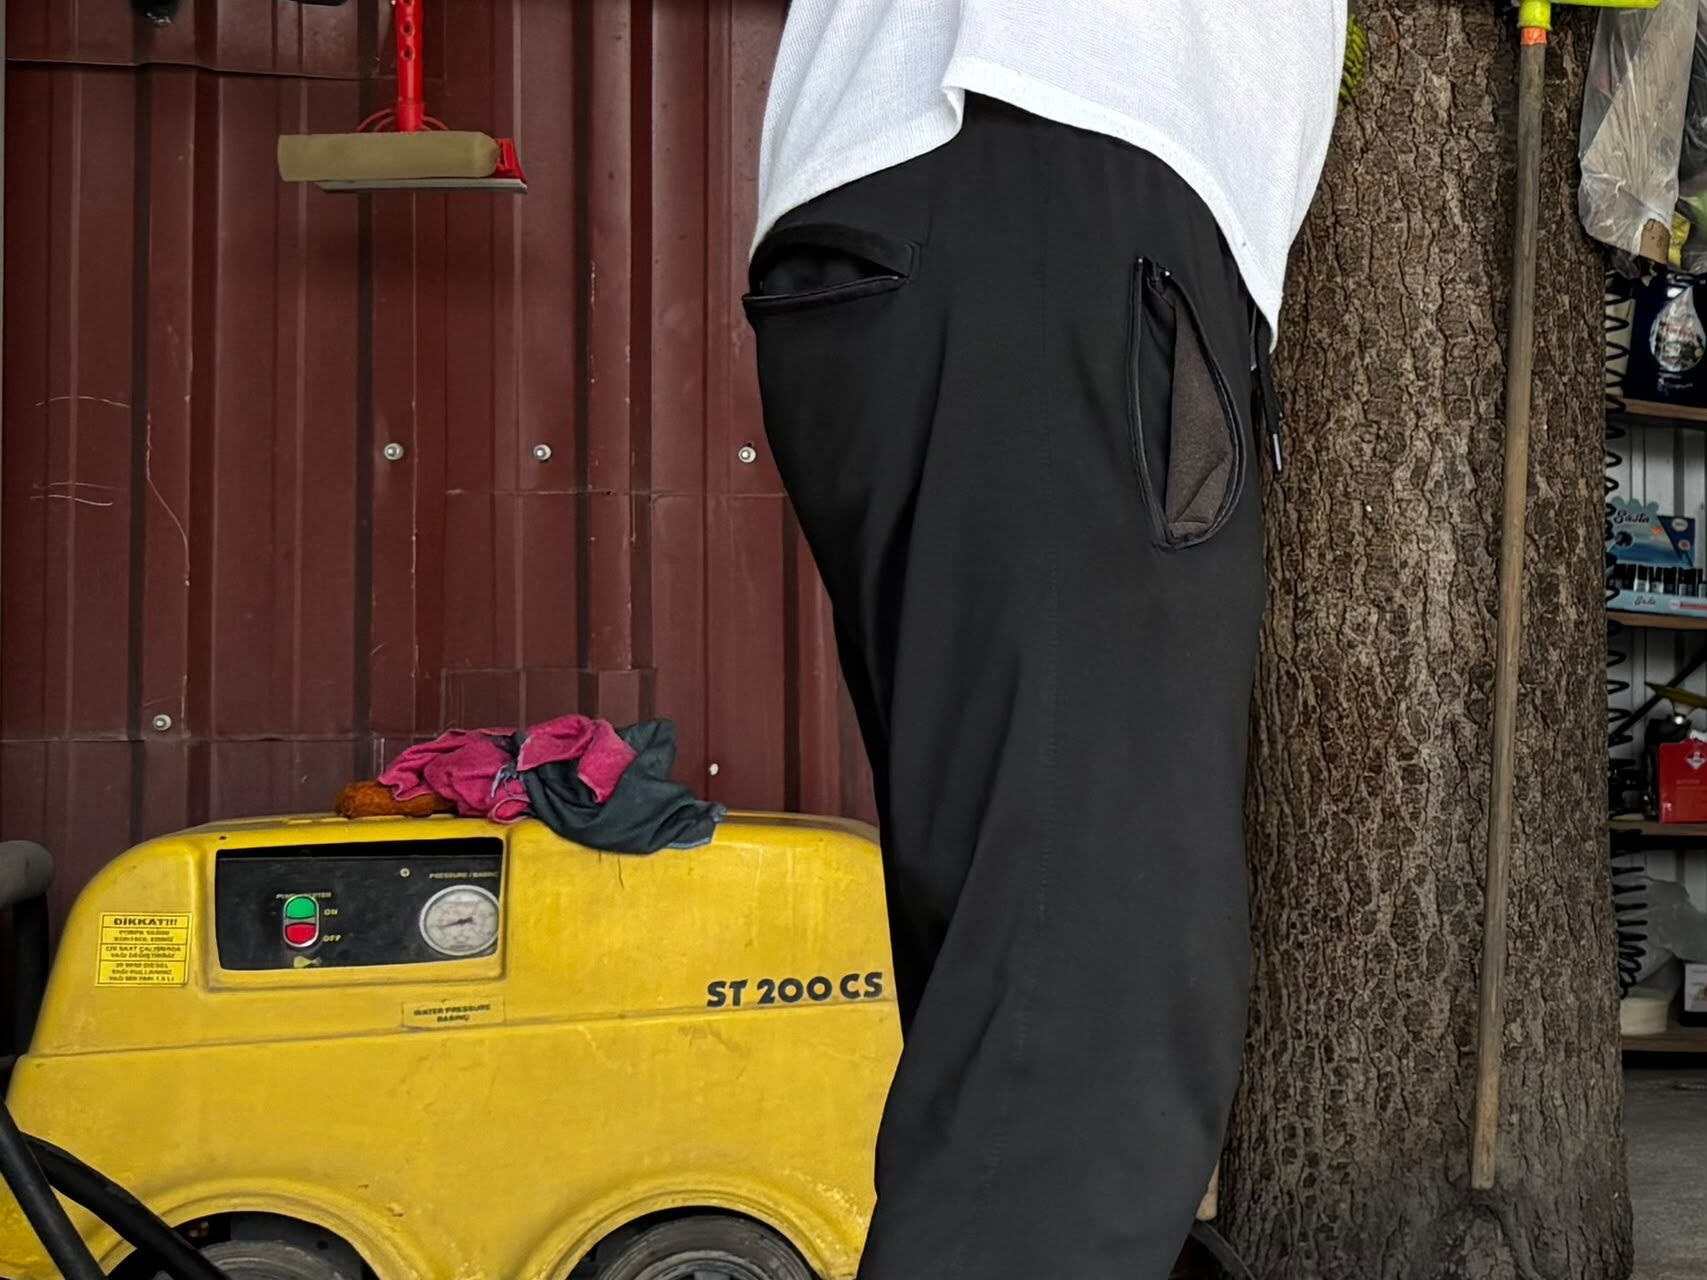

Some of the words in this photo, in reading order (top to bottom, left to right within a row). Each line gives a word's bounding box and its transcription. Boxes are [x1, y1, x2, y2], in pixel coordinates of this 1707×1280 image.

[706, 979, 748, 1007] ST
[757, 976, 832, 1004] 200
[839, 972, 883, 999] CS
